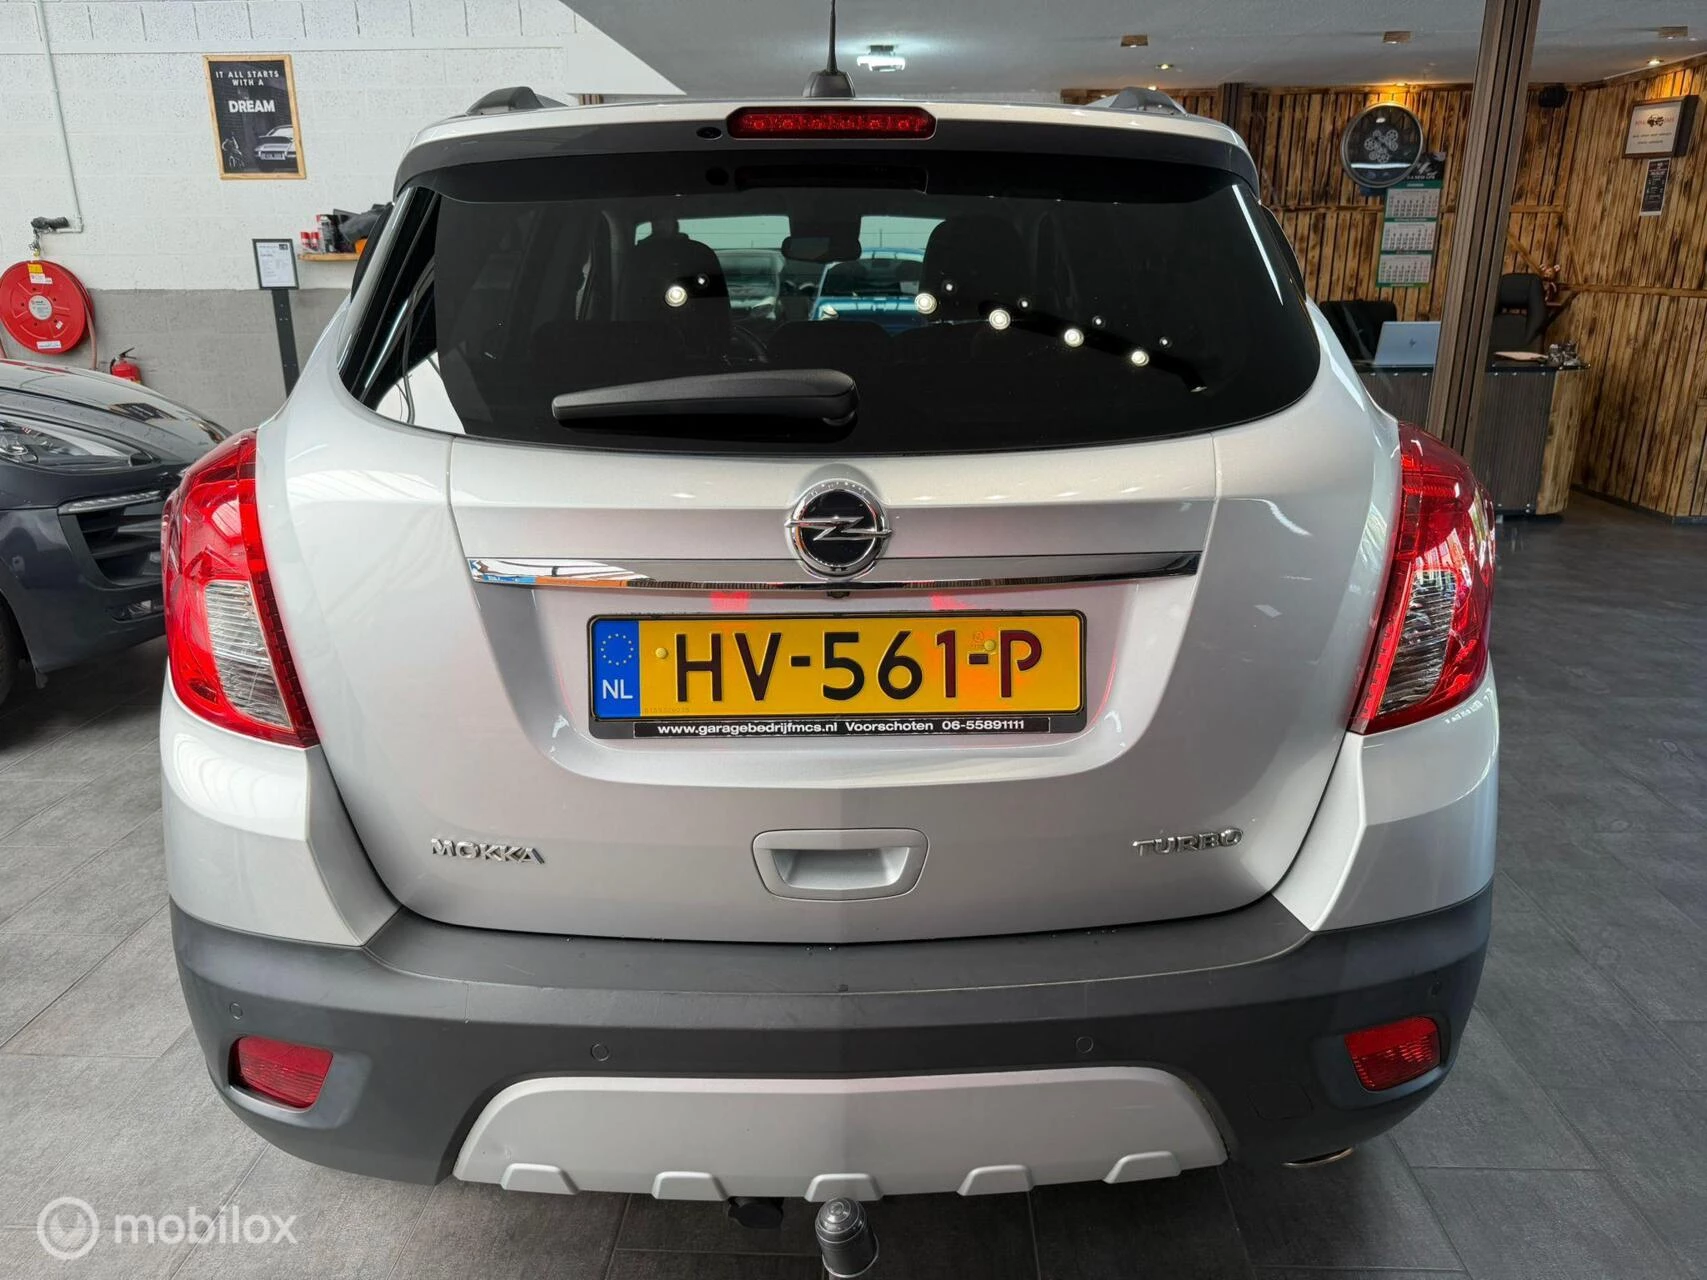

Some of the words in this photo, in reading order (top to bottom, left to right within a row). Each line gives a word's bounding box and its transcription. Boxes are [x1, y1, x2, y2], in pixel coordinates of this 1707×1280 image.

[247, 70, 280, 78] STARTS
[228, 99, 276, 113] DREAM
[675, 629, 1043, 702] HV-561-P
[602, 679, 634, 700] NL
[657, 722, 838, 736] www.garagebedrijfmcs.nl
[845, 720, 934, 732] Voorschoten
[941, 719, 1025, 731] 06-55891111
[430, 838, 546, 865] MOKKA
[1131, 827, 1243, 857] TURBO
